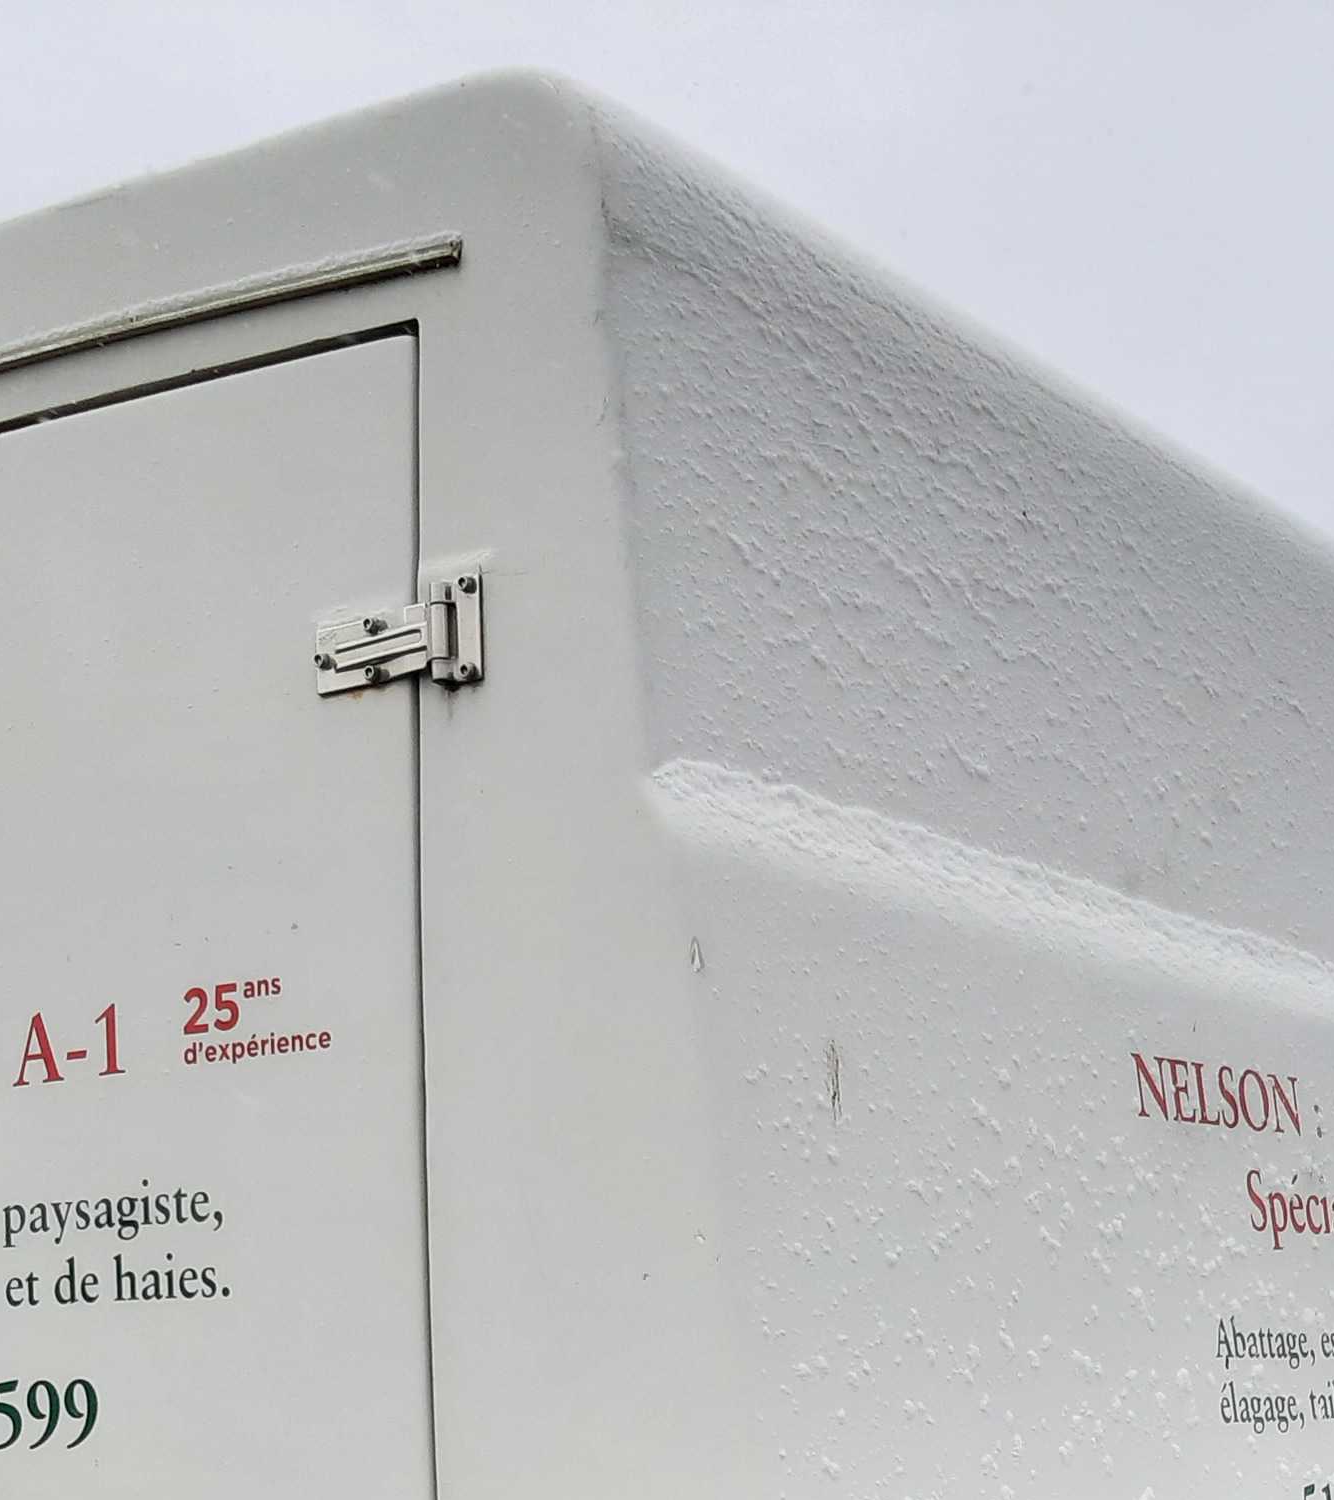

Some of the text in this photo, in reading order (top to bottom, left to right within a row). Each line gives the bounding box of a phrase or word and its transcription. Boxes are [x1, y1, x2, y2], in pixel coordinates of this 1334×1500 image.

[183, 977, 282, 1035] 25 ans
[13, 1003, 127, 1087] A-1
[183, 1030, 332, 1065] d'expérience
[1130, 1053, 1302, 1136] NELSON
[2, 1179, 224, 1249] paysagiste,
[5, 1271, 40, 1308] et
[53, 1257, 100, 1305] de
[113, 1253, 232, 1302] haies.
[1216, 1316, 1316, 1369] Abattage,
[1220, 1381, 1305, 1434] élagage,
